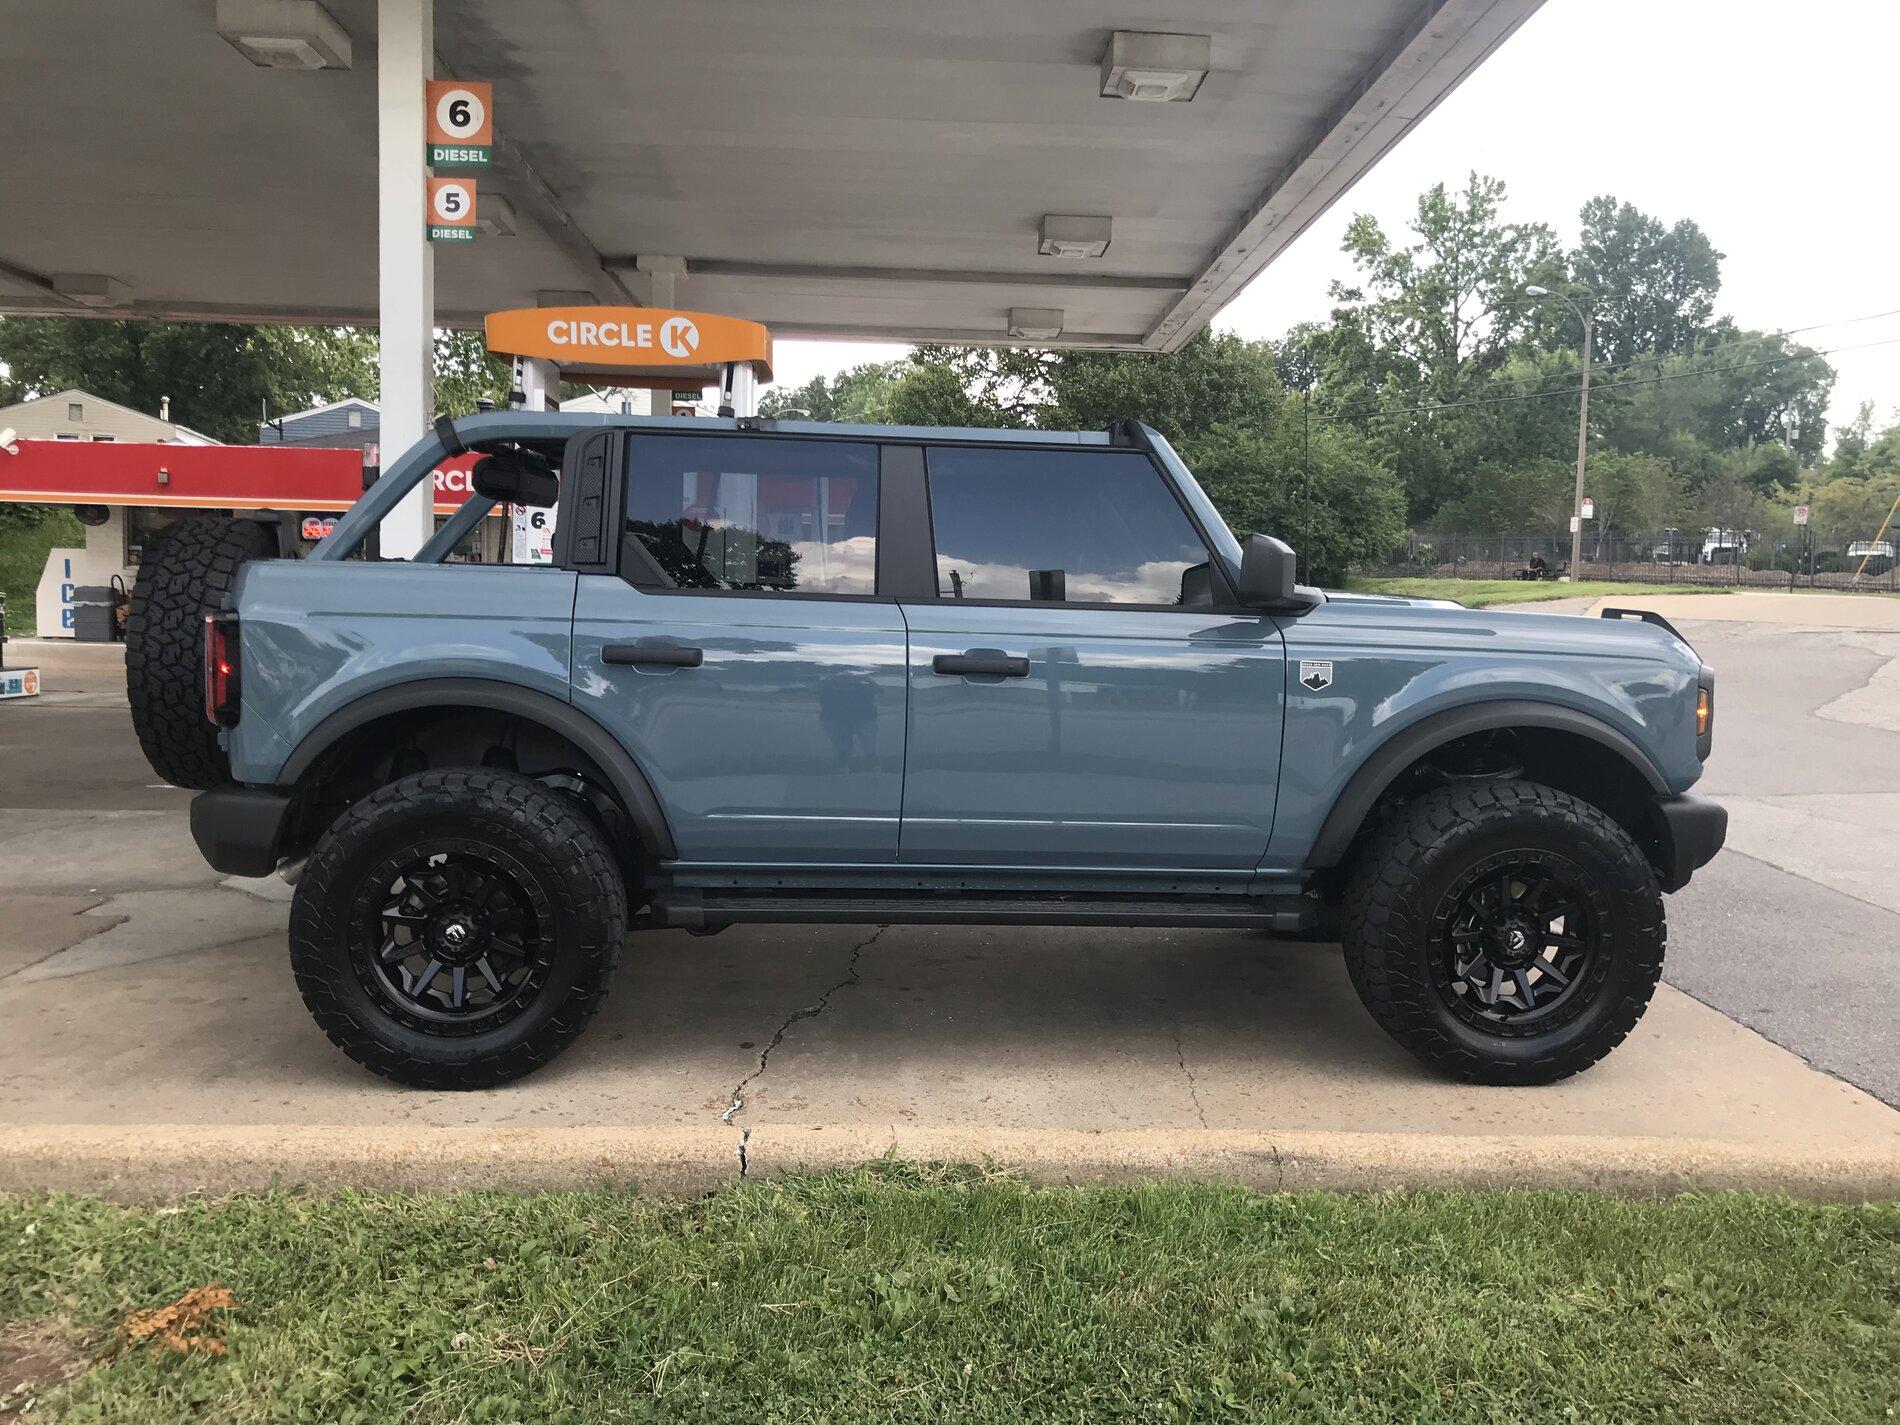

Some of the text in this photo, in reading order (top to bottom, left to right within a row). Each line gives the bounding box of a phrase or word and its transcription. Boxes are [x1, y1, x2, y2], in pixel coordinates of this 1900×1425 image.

[449, 100, 471, 127] 6
[433, 149, 488, 162] DIESEL
[445, 193, 461, 213] 5
[432, 229, 473, 239] DIESEL
[547, 317, 699, 358] CIRCLE K
[675, 392, 702, 400] DIESEL
[433, 469, 476, 492] RCL
[531, 511, 546, 529] 6
